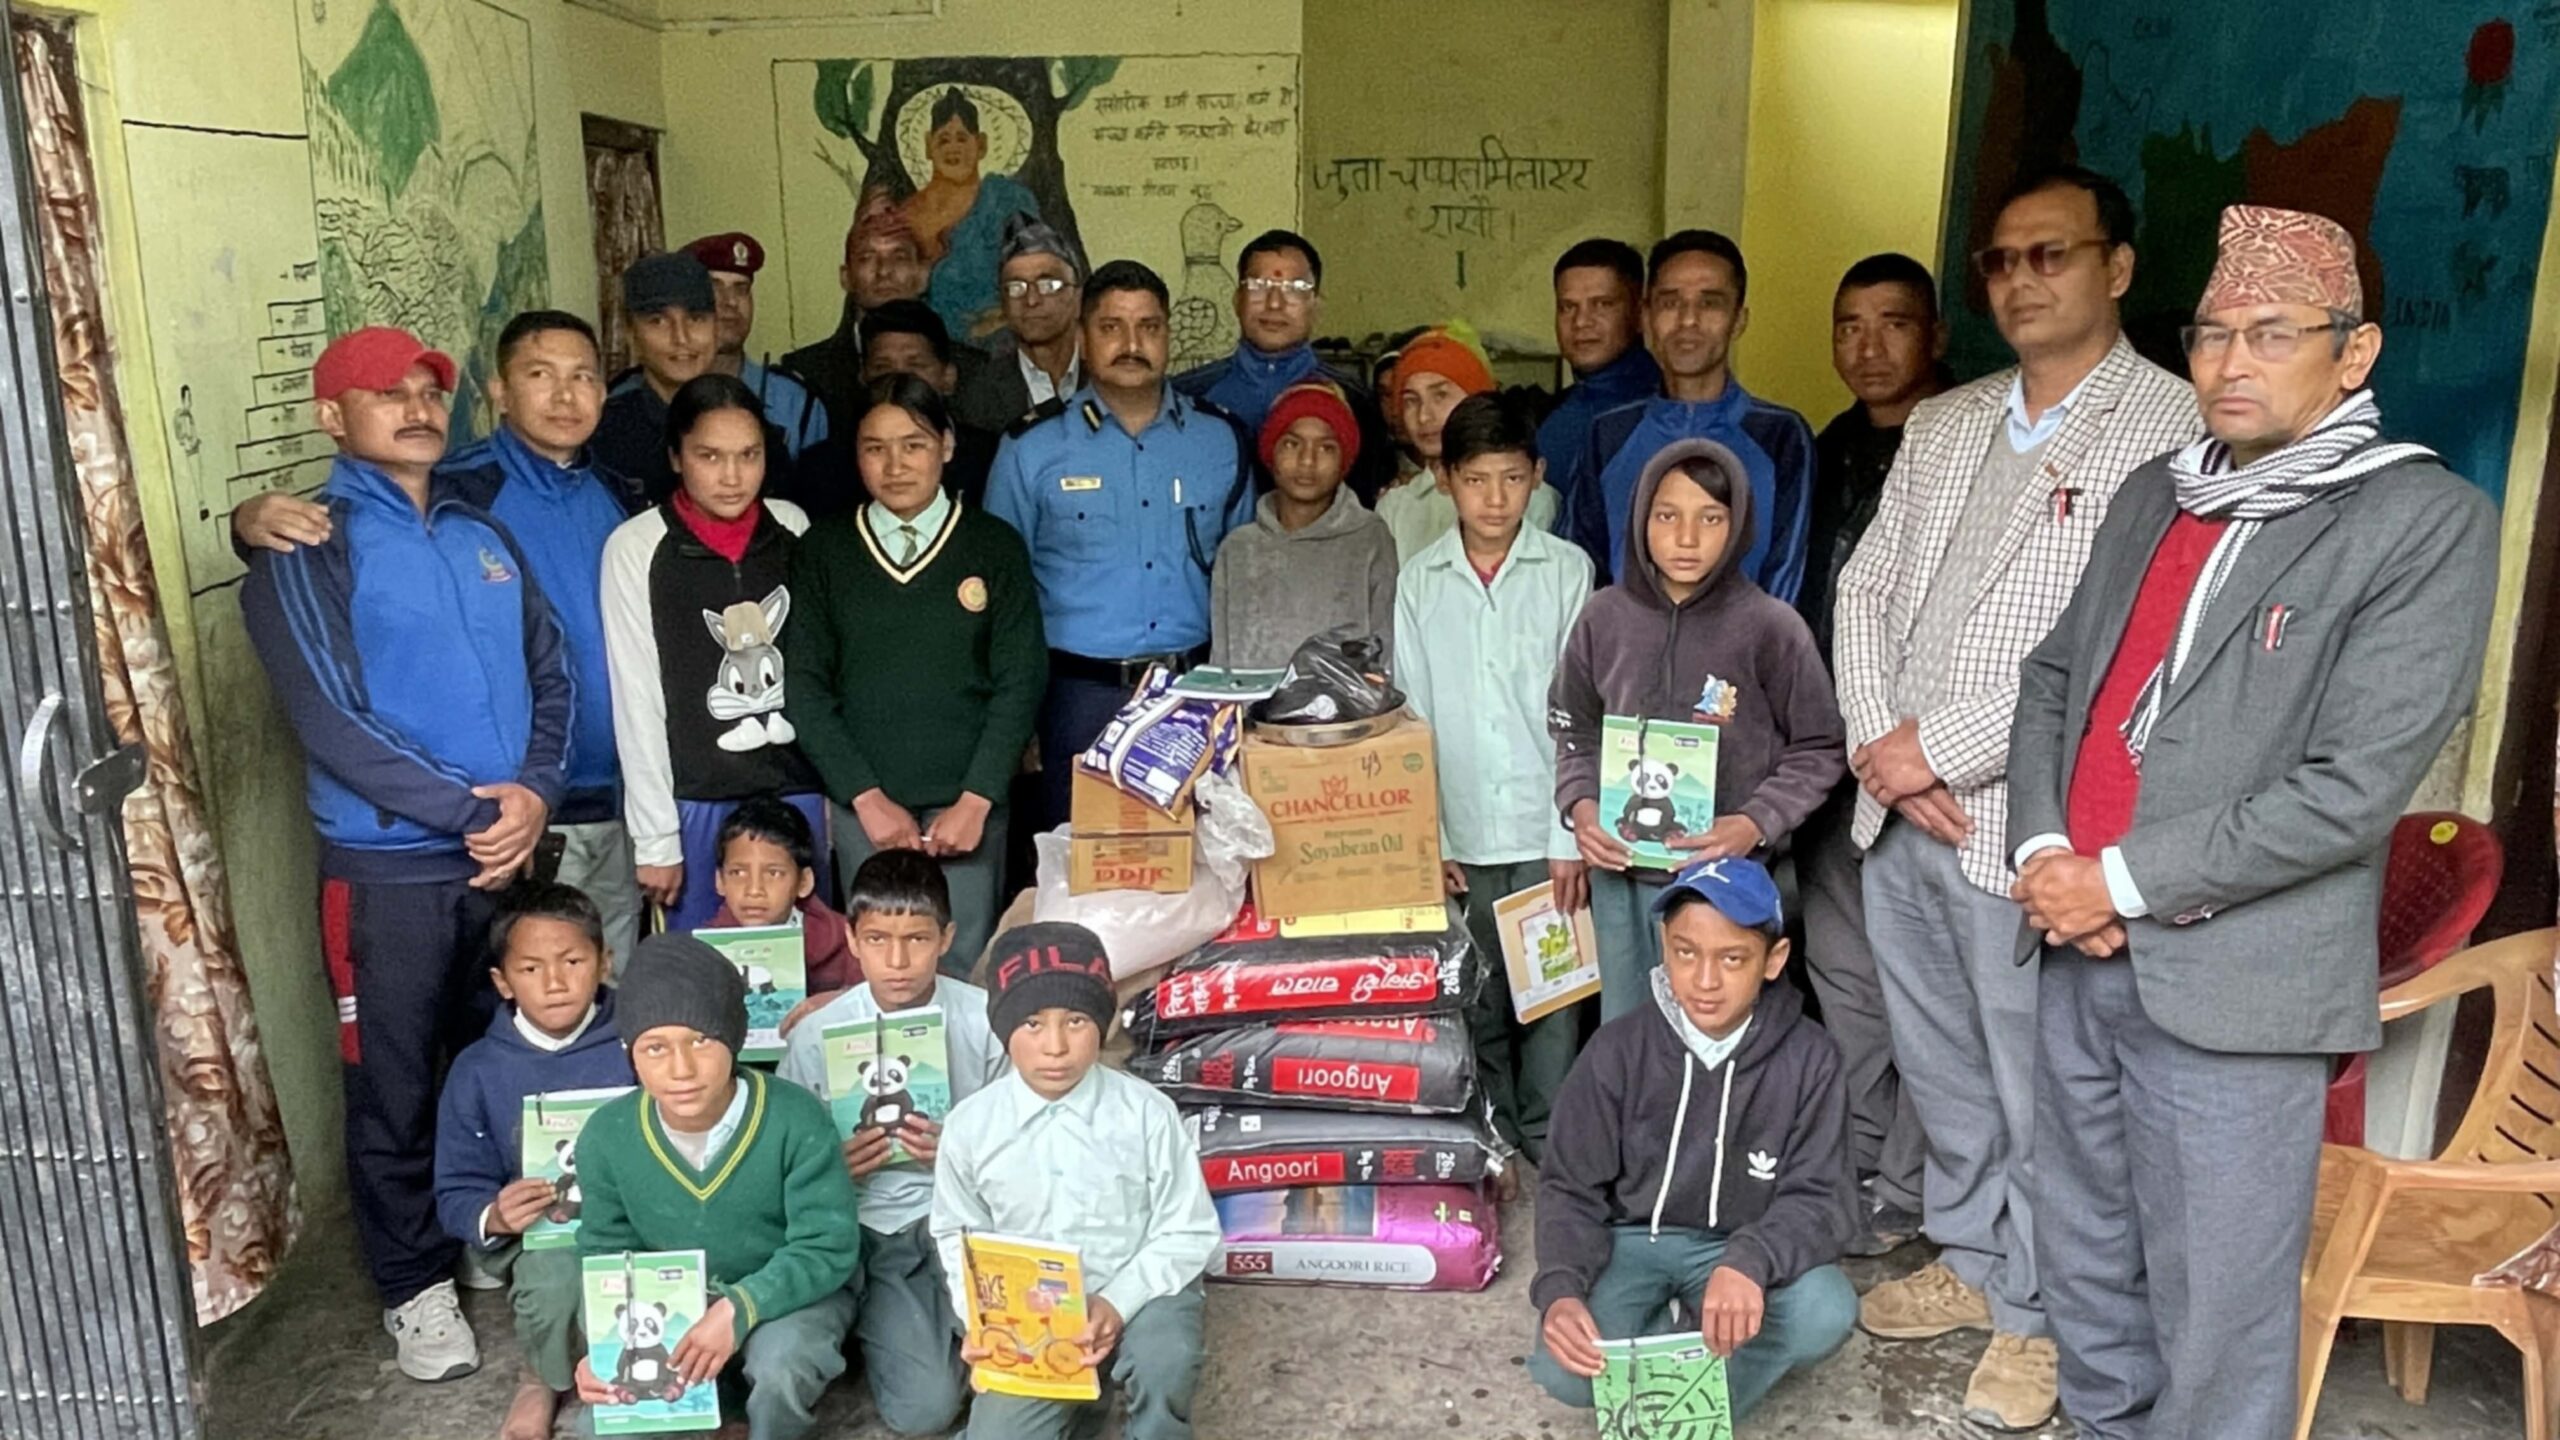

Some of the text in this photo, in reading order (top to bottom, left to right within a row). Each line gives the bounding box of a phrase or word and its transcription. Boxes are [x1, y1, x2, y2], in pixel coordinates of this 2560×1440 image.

[1269, 789, 1413, 819] CHANCELLOR
[1300, 834, 1404, 865] Soyabean Oil
[997, 944, 1114, 992] FILA
[1268, 976, 1341, 996] चावल
[1297, 1065, 1393, 1095] Angoori
[1227, 1155, 1319, 1183] Angoori
[1233, 1255, 1267, 1270] 555
[1296, 1260, 1412, 1274] ANGOORI RICE
